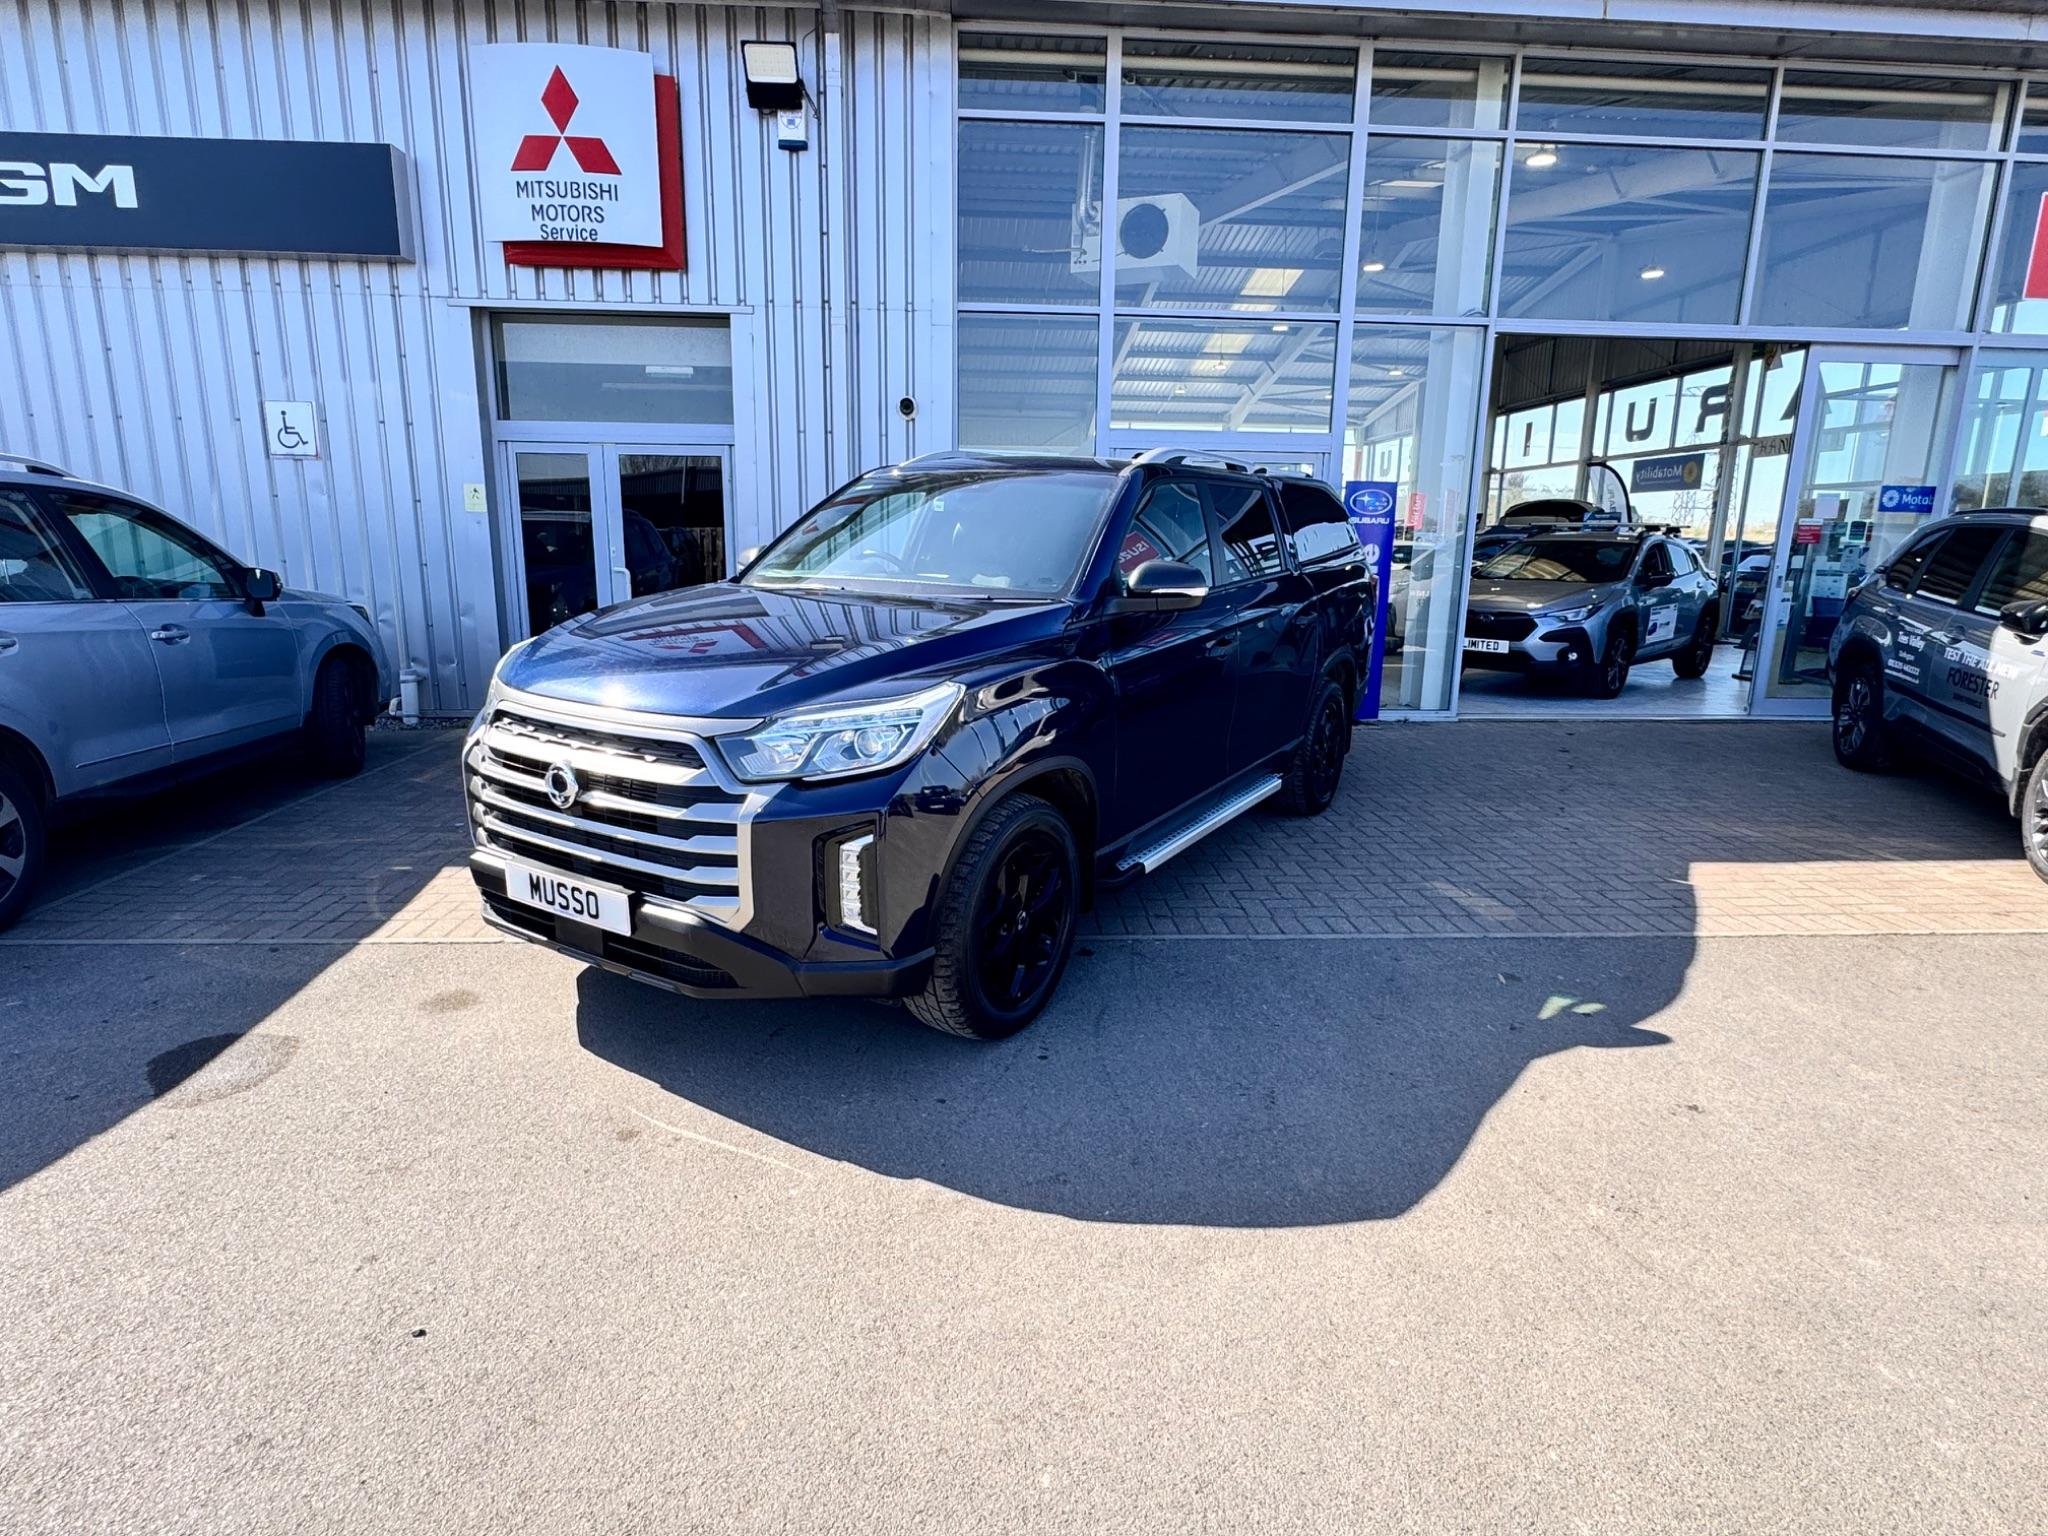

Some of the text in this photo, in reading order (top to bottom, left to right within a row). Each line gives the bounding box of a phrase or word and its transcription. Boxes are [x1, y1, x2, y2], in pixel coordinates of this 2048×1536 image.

[516, 180, 619, 202] MITSUBISHI
[531, 203, 605, 224] MOTORS
[540, 223, 599, 242] Service
[1350, 516, 1390, 524] SUBARU
[1944, 647, 1961, 662] TEST
[1961, 652, 1979, 668] THE
[1946, 667, 2000, 700] FORESTER
[528, 872, 599, 919] MUSSO
